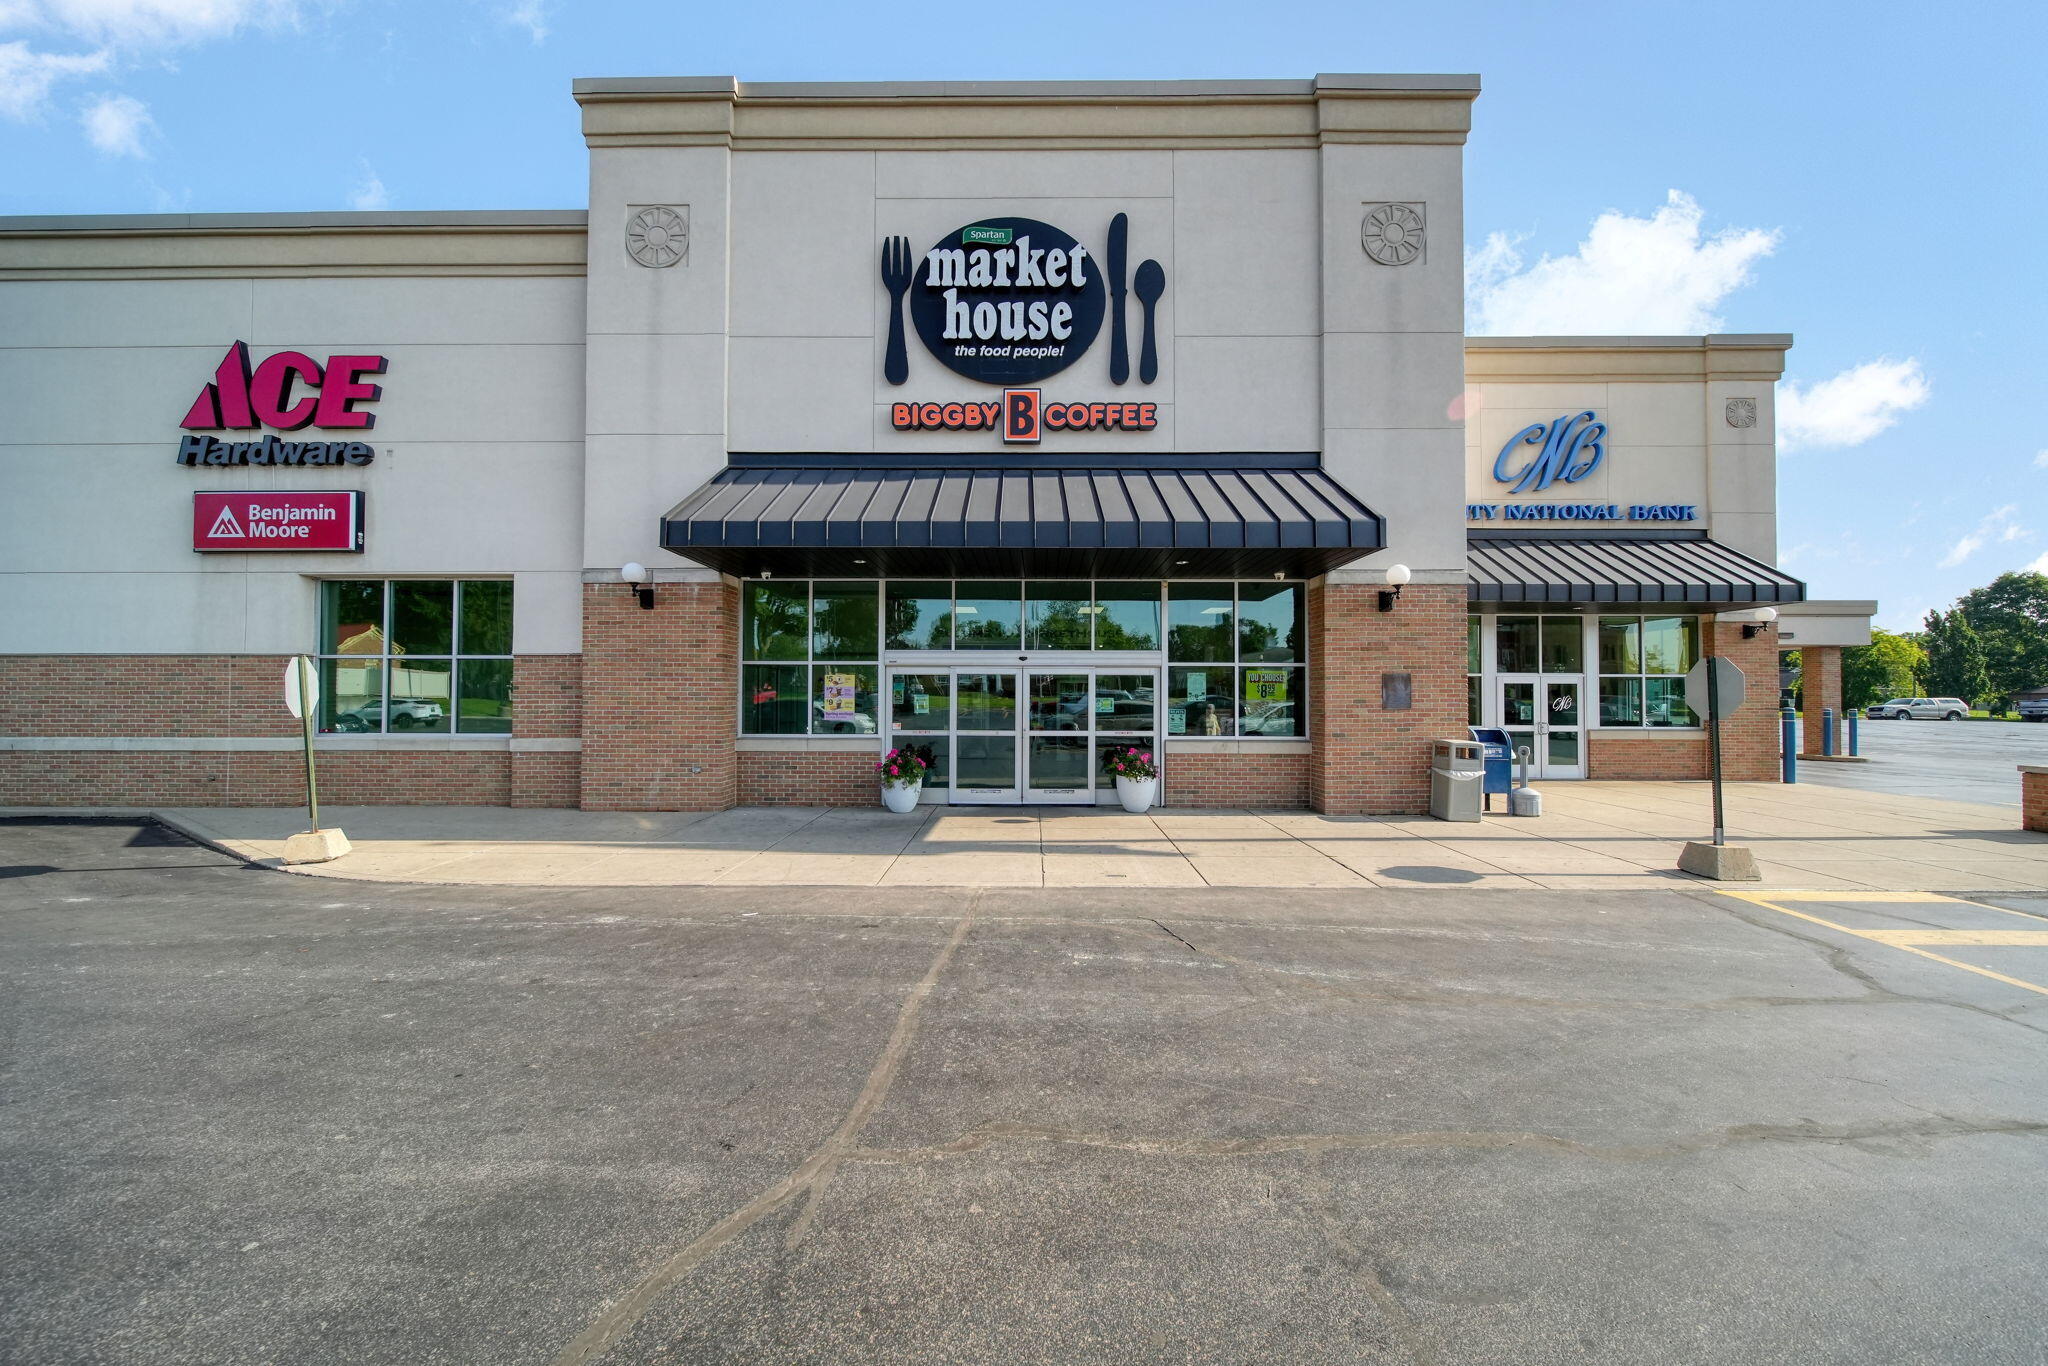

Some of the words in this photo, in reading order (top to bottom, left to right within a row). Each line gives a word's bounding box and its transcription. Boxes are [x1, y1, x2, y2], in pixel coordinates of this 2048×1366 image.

[970, 230, 1005, 240] Spartan
[925, 235, 1087, 288] market
[942, 288, 1073, 341] house
[954, 345, 977, 357] the
[980, 345, 1012, 357] food
[1012, 345, 1065, 359] people!
[179, 339, 389, 431] ACE
[892, 402, 1001, 428] BIGGBY
[1008, 393, 1036, 437] B
[1045, 402, 1157, 429] COFFEE
[177, 435, 375, 466] Hardware
[249, 503, 336, 525] Benjamin
[1504, 504, 1626, 521] NATIONAL
[1629, 503, 1698, 521] BANK
[249, 521, 310, 538] Moore
[1248, 673, 1259, 682] YOU
